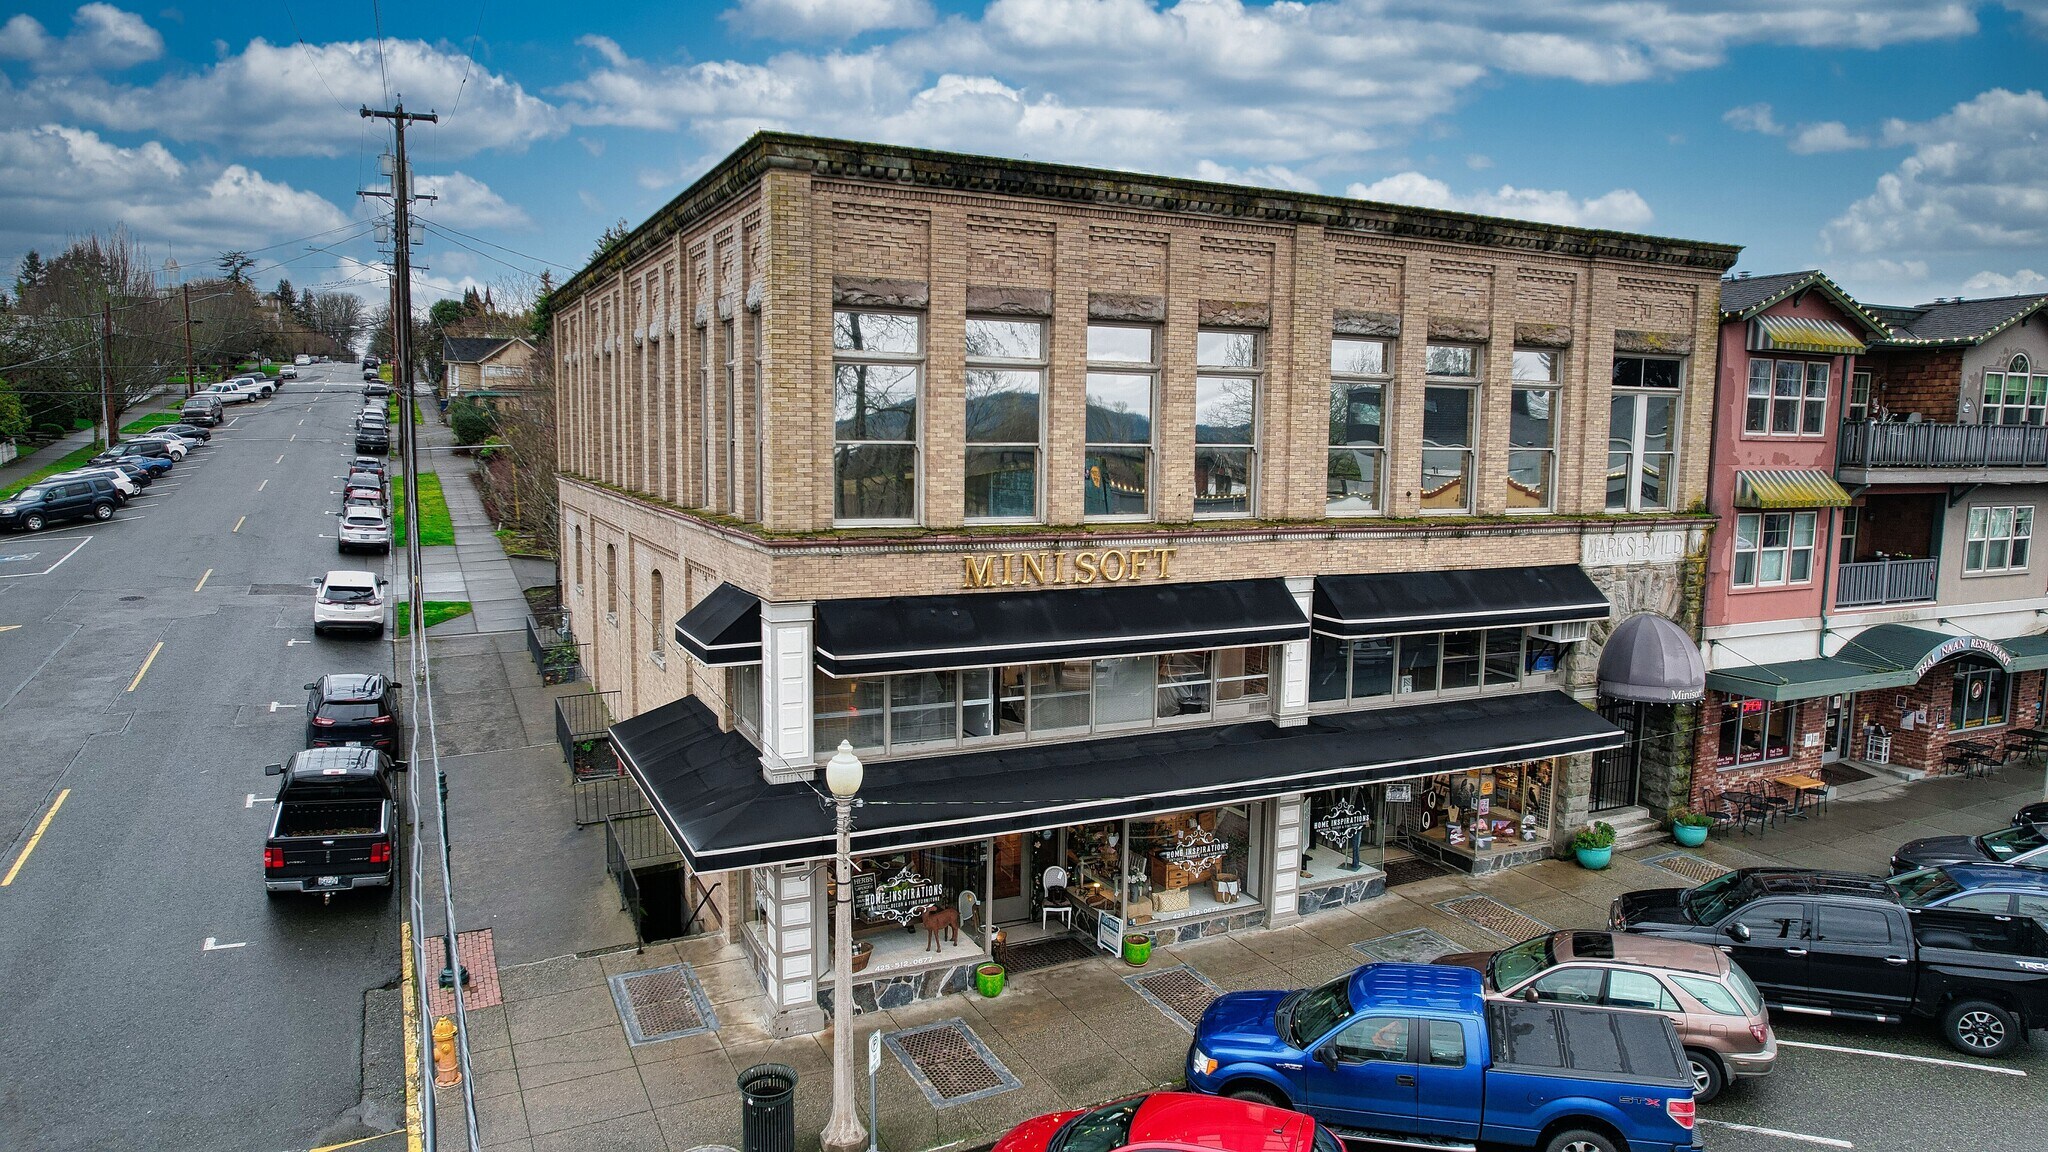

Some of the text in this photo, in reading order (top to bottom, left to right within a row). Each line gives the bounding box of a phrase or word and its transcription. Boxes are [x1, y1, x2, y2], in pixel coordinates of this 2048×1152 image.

[962, 548, 1177, 588] MINISOFT
[1917, 638, 2012, 678] THAI NAAN RESTAURANT
[1331, 814, 1370, 827] INSPIRATIONS
[1166, 849, 1184, 859] HOME
[1185, 842, 1229, 856] INSPIRATIONS
[865, 892, 886, 906] HOME
[889, 883, 943, 903] INSPIRATIONS
[1619, 1096, 1660, 1107] STX
